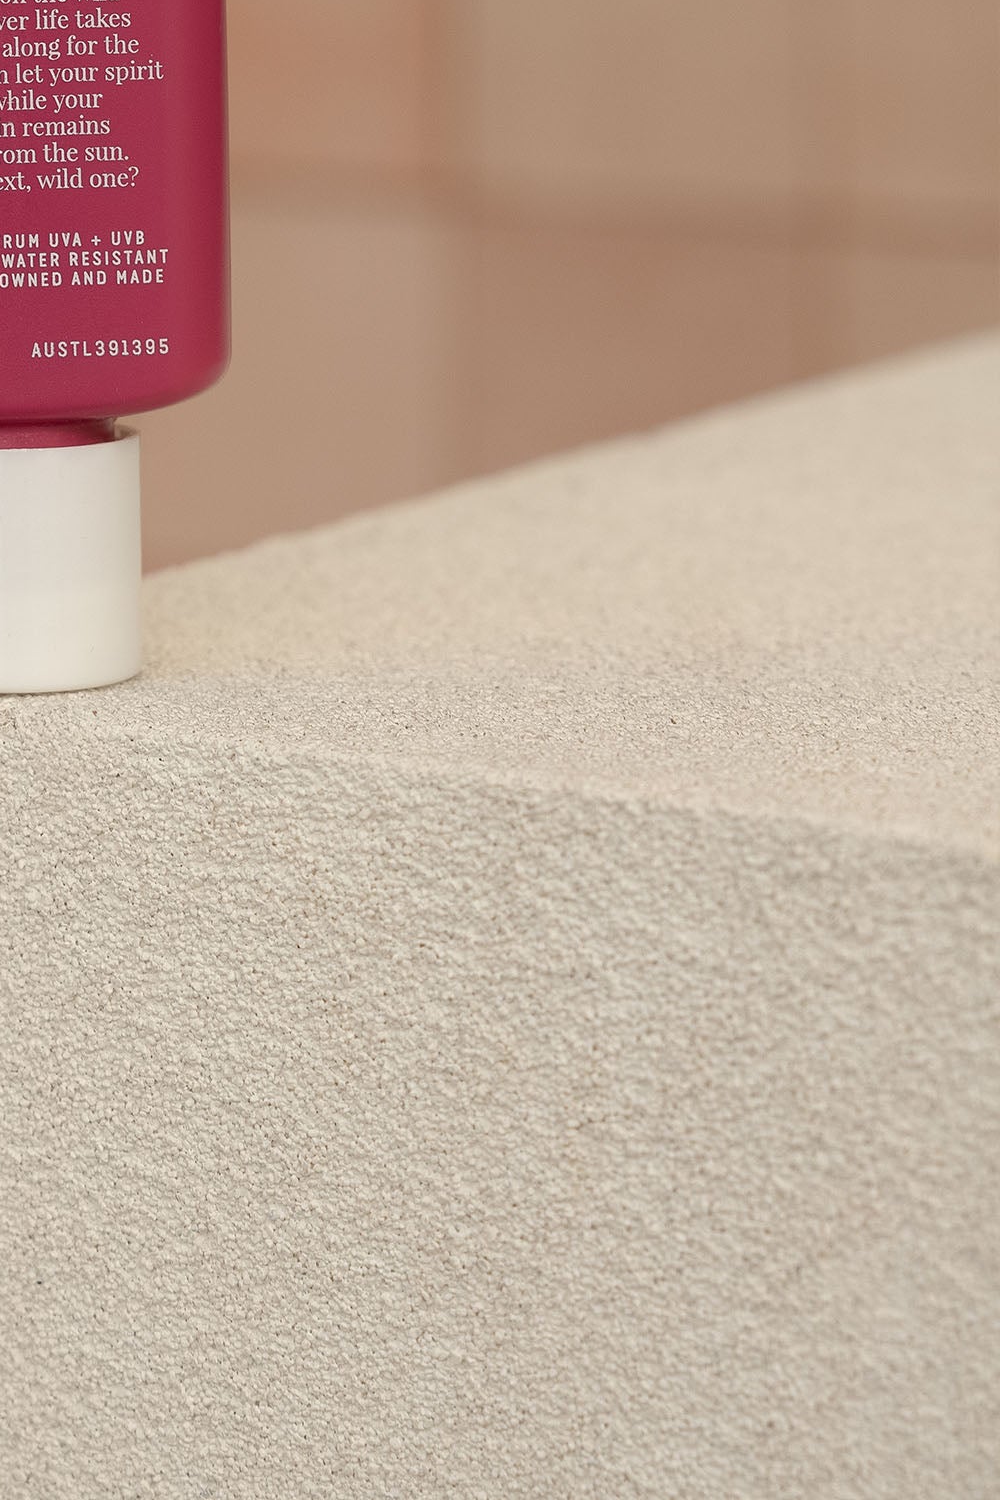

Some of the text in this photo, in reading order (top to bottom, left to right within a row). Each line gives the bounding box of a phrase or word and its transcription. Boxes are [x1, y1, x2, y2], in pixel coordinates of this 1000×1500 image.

[34, 8, 69, 30] life
[74, 6, 132, 29] takes
[2, 35, 61, 61] along
[65, 34, 99, 56] for
[103, 33, 140, 55] the
[14, 62, 44, 84] let
[48, 66, 99, 87] your
[104, 59, 165, 86] spirit
[52, 93, 104, 114] your
[21, 115, 111, 137] remains
[42, 141, 79, 163] the
[84, 146, 130, 162] sun.
[36, 167, 84, 190] wild
[89, 165, 140, 189] one?
[48, 231, 82, 248] UVA
[90, 235, 102, 247] +
[111, 229, 145, 246] UVB
[0, 251, 60, 269] WATER
[68, 248, 169, 267] RESISTANT
[71, 270, 107, 286] AND
[116, 268, 164, 285] MADE
[31, 337, 169, 359] AUSTL391395
